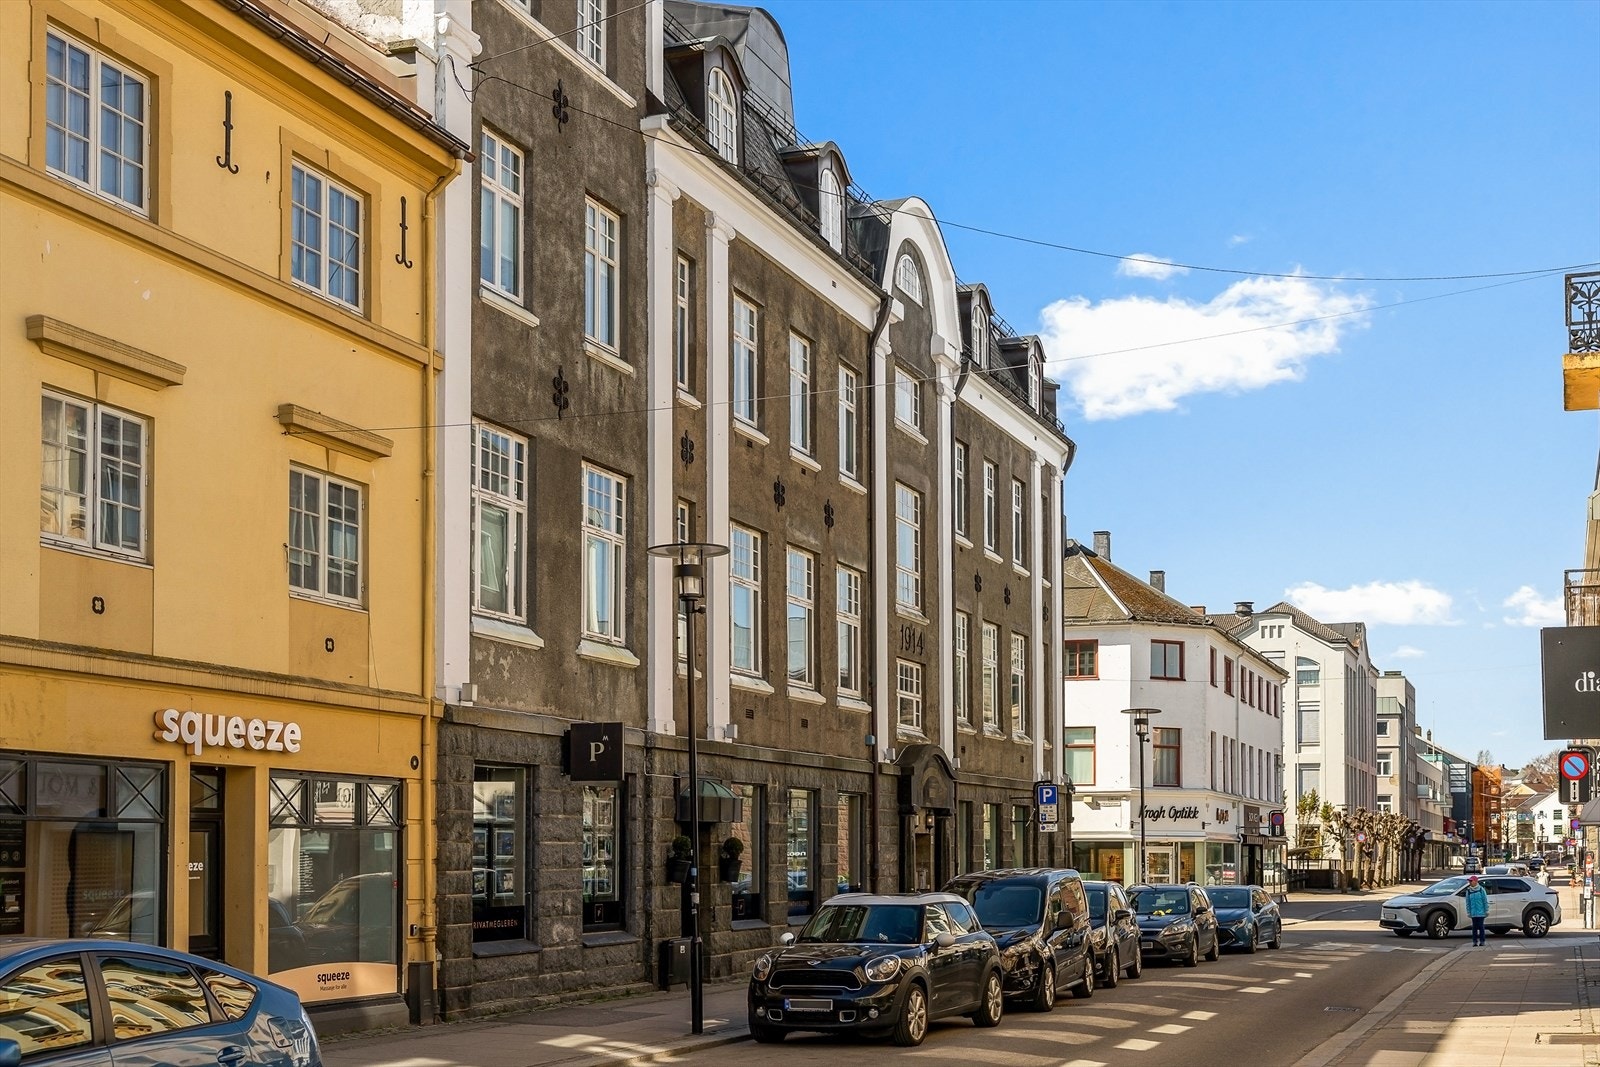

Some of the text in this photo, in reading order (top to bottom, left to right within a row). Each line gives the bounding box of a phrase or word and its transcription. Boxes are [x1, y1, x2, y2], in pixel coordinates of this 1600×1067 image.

[900, 623, 924, 656] 1914
[155, 708, 302, 756] squeeze
[1043, 788, 1053, 803] P
[1168, 805, 1200, 823] Optikk
[188, 862, 204, 871] eze
[472, 919, 518, 929] RIVATMEGLEREN
[317, 971, 350, 984] squeeze
